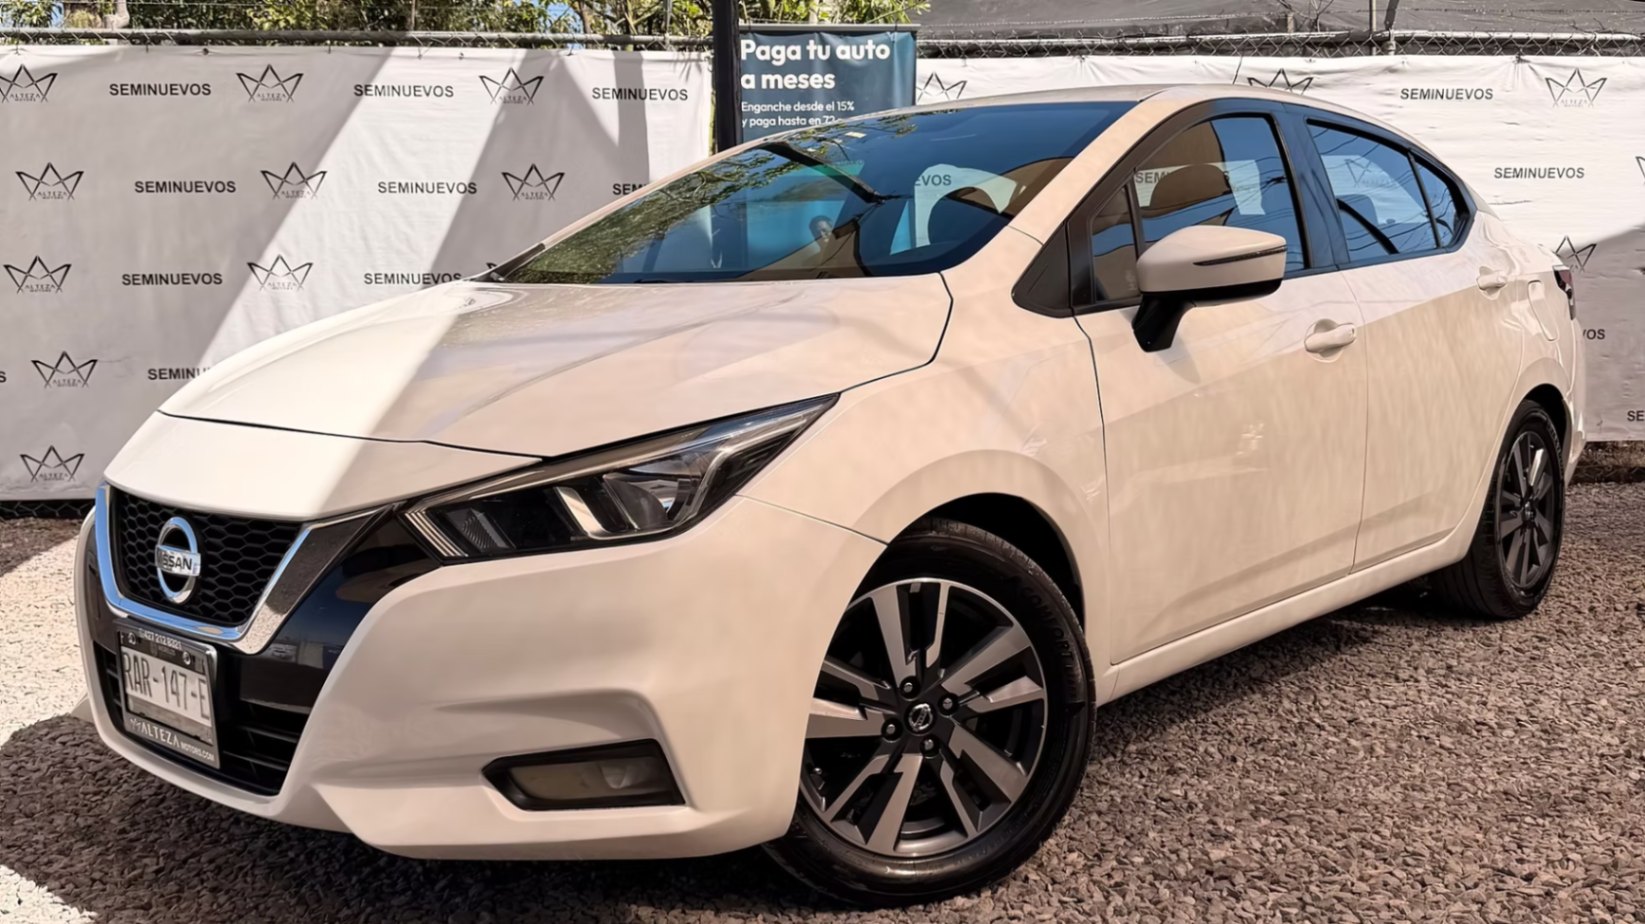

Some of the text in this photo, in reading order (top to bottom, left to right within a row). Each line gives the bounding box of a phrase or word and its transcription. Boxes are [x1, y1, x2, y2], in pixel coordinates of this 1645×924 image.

[741, 39, 890, 66] Paga tu auto
[740, 73, 836, 89] a meses
[109, 83, 211, 96] SEMINUEVOS
[354, 84, 454, 98] SEMINUEVOS
[592, 87, 688, 101] SEMINUEVOS
[1400, 88, 1493, 100] SEMINUEVOS
[741, 101, 855, 114] Enganche desde el 15%
[742, 119, 749, 128] y
[749, 119, 776, 128] paga
[778, 116, 807, 126] hasta
[1494, 168, 1584, 179] SEMINUEVOS
[135, 181, 236, 193] SEMINUEVOS
[378, 181, 477, 194] SEMINUEVOS
[122, 273, 222, 286] SEMINUEVOS
[364, 273, 462, 285] SEMINUEVOS
[148, 367, 210, 380] SEMIN
[122, 653, 211, 721] RAR-147-E
[142, 721, 180, 748] ALTEZA
